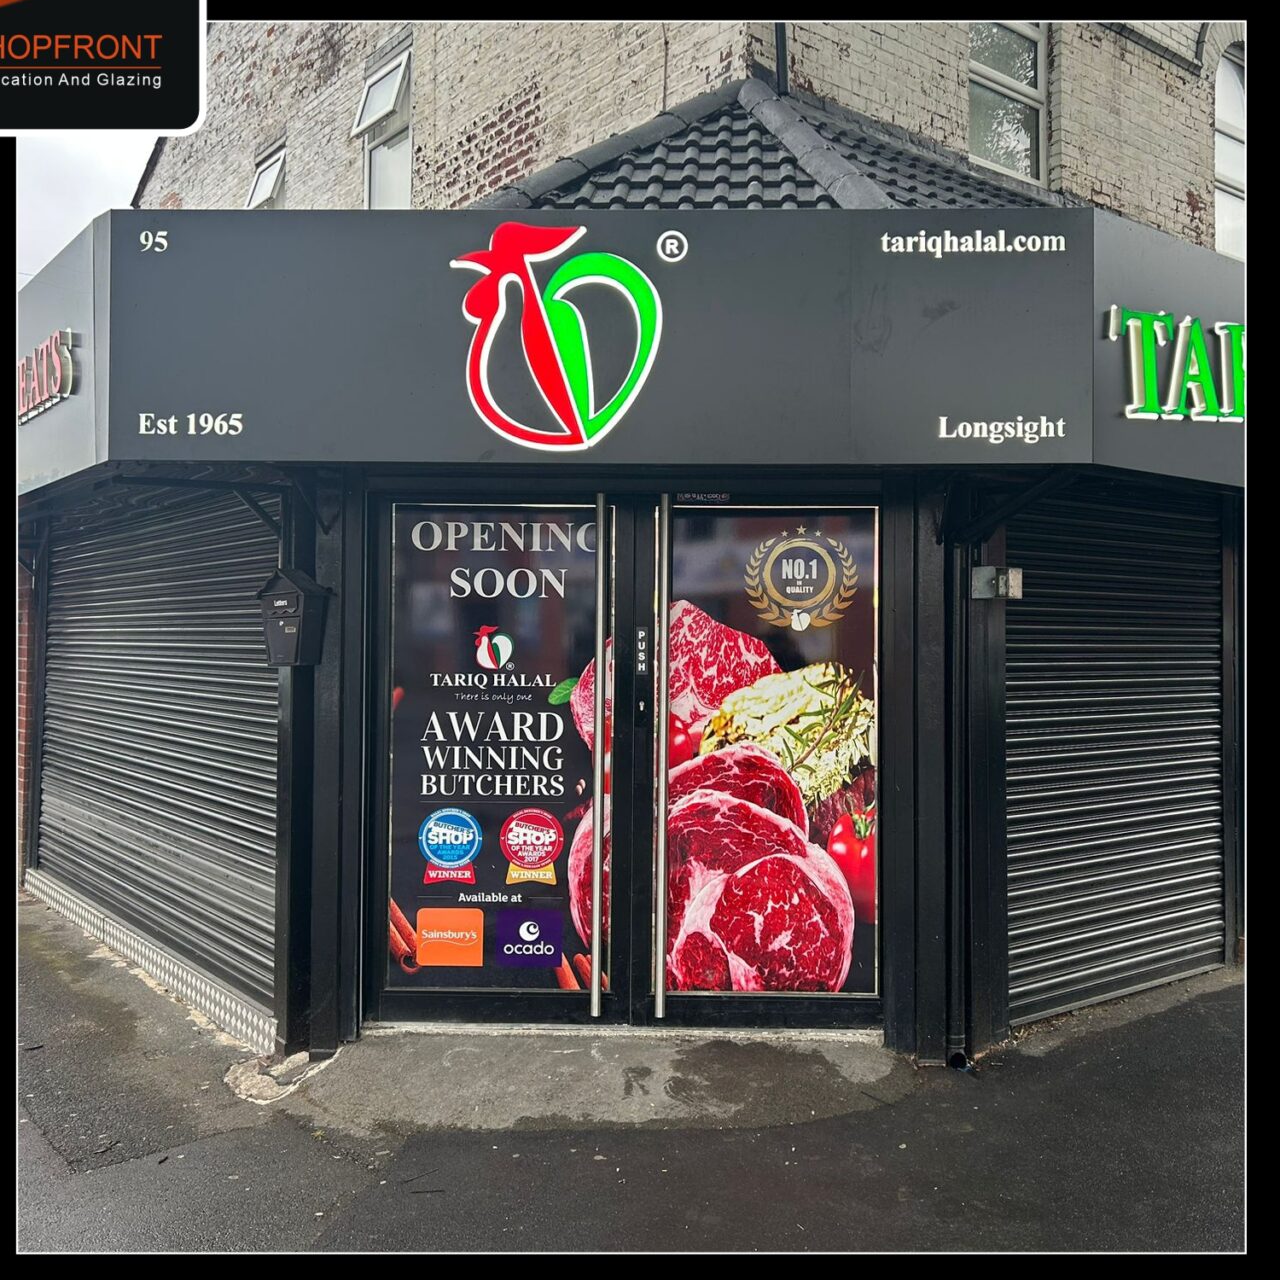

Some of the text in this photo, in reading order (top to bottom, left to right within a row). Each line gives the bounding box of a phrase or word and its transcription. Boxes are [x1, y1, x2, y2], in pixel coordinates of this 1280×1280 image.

[139, 230, 169, 252] 95
[880, 229, 1067, 258] tariqhalal.com
[138, 412, 244, 436] Est 1965
[938, 415, 1067, 443] Longsight
[781, 558, 818, 580] NO.1
[450, 567, 569, 599] SOON
[785, 585, 814, 594] QUALITY
[638, 630, 646, 672] PUSH
[429, 673, 557, 689] TARIQ HALAL
[455, 691, 533, 705] There is only one
[420, 711, 564, 741] AWARD
[420, 745, 565, 771] WINNING
[420, 773, 565, 797] BUTCHERS
[433, 821, 472, 834] BUTCHER'S
[514, 821, 551, 834] BUTCHER'S
[427, 830, 474, 845] SHOP
[507, 830, 557, 845] SHOP
[428, 870, 472, 879] WINNER
[510, 870, 553, 880] WINNER
[458, 892, 523, 903] Available at
[421, 929, 477, 940] Sainsbury's
[503, 941, 555, 956] ocado
